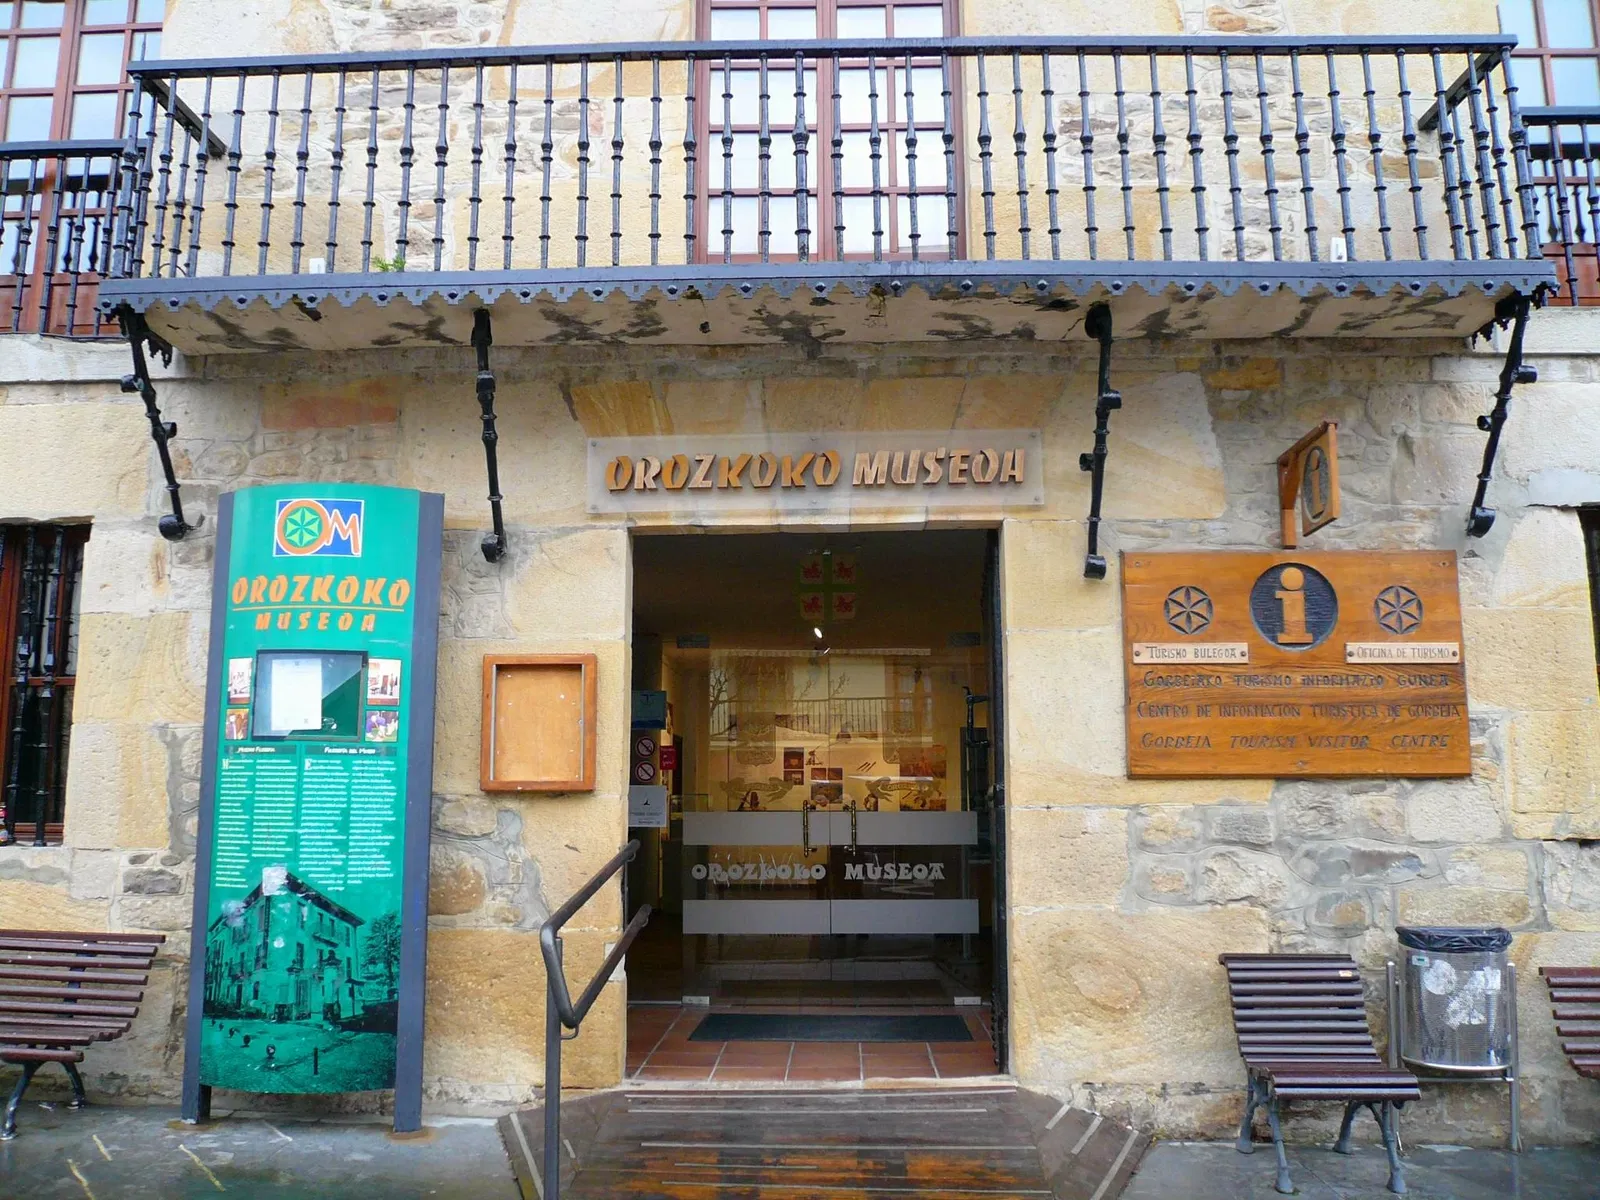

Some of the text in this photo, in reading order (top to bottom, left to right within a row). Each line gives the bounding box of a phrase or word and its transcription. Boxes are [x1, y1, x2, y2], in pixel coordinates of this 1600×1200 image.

[605, 447, 1025, 492] OROZKOKO MUSEOA
[232, 574, 411, 607] OROZKOKO
[255, 611, 376, 632] MUSEOA
[1193, 647, 1237, 659] BULEGOA
[1356, 646, 1450, 659] OFICINA DE TURISMO
[1397, 673, 1450, 688] GUNEA
[1136, 701, 1189, 719] CENTRO
[1197, 704, 1211, 718] DE
[1311, 704, 1378, 718] TURISTICA
[1387, 704, 1401, 718] DE
[1407, 703, 1461, 718] GORBEIA
[1141, 732, 1450, 749] GORBEIA TOURISM VISITOR CENTRE
[691, 862, 946, 882] OROZKOKO MUSEOA
